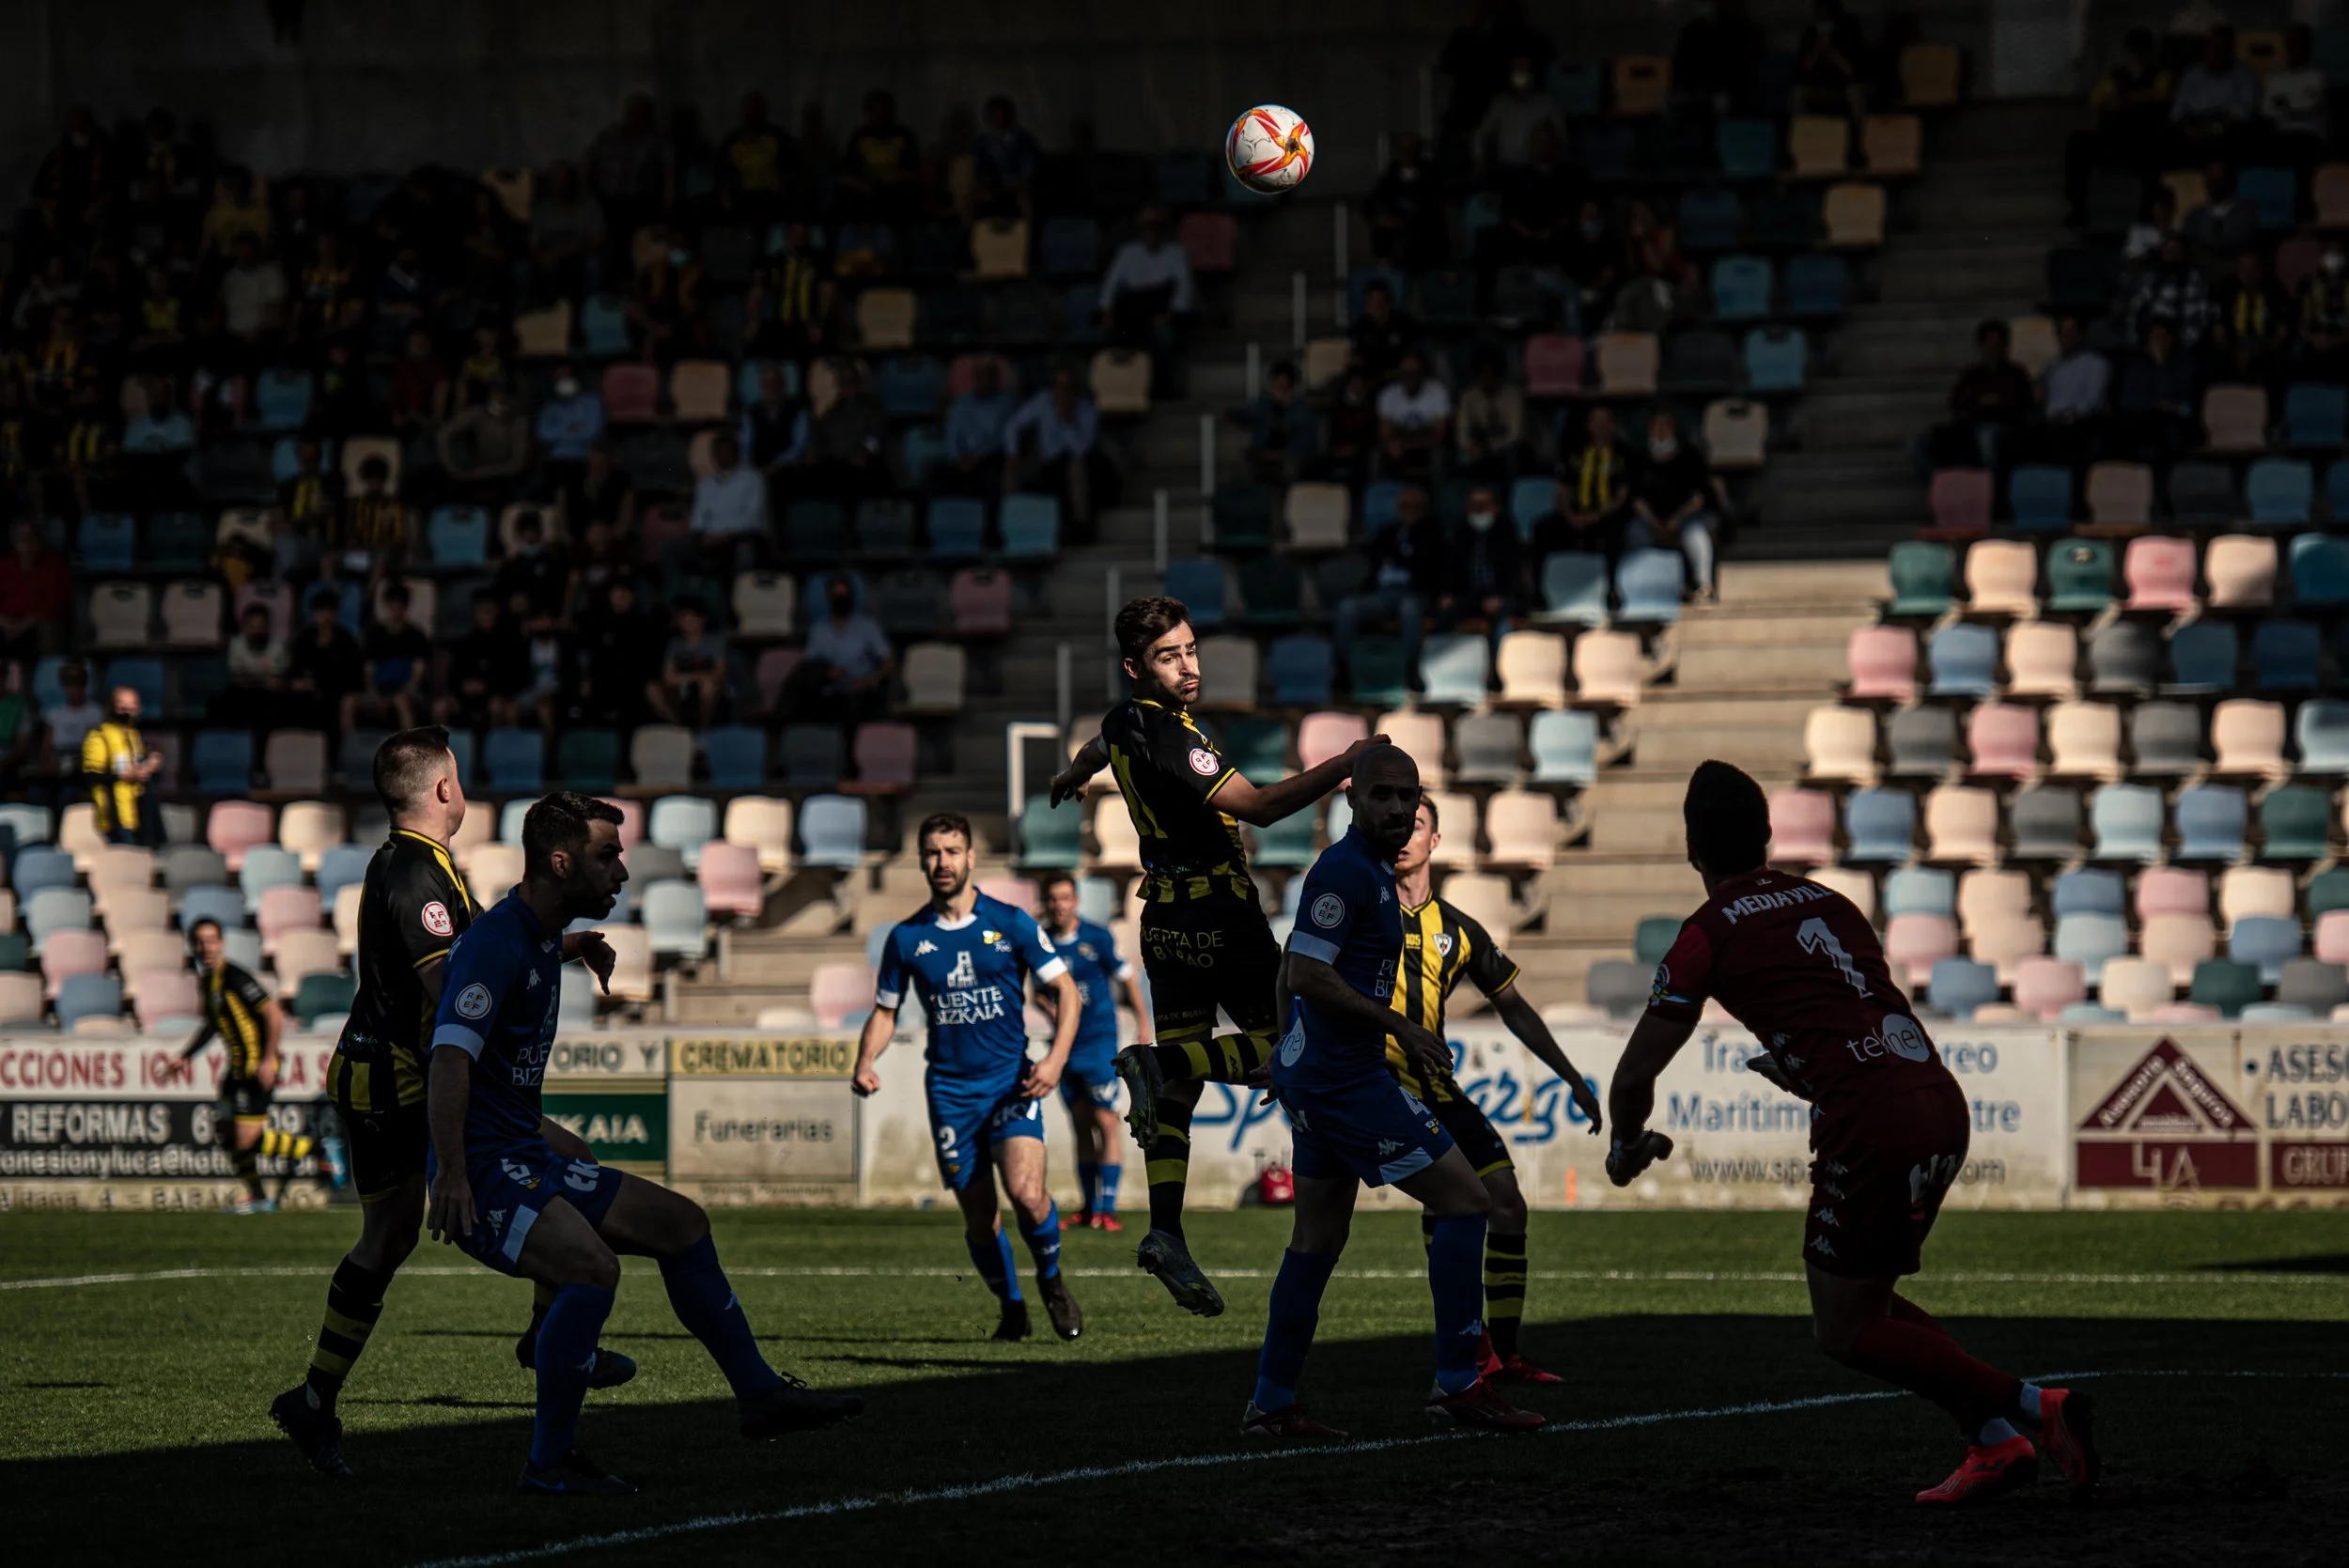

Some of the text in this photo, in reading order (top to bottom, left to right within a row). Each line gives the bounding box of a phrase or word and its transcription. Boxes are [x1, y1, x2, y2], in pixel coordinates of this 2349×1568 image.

[680, 1041, 850, 1072] CREMATORIO
[12, 1103, 172, 1143] REFORMAS
[694, 1110, 834, 1142] Funerarias
